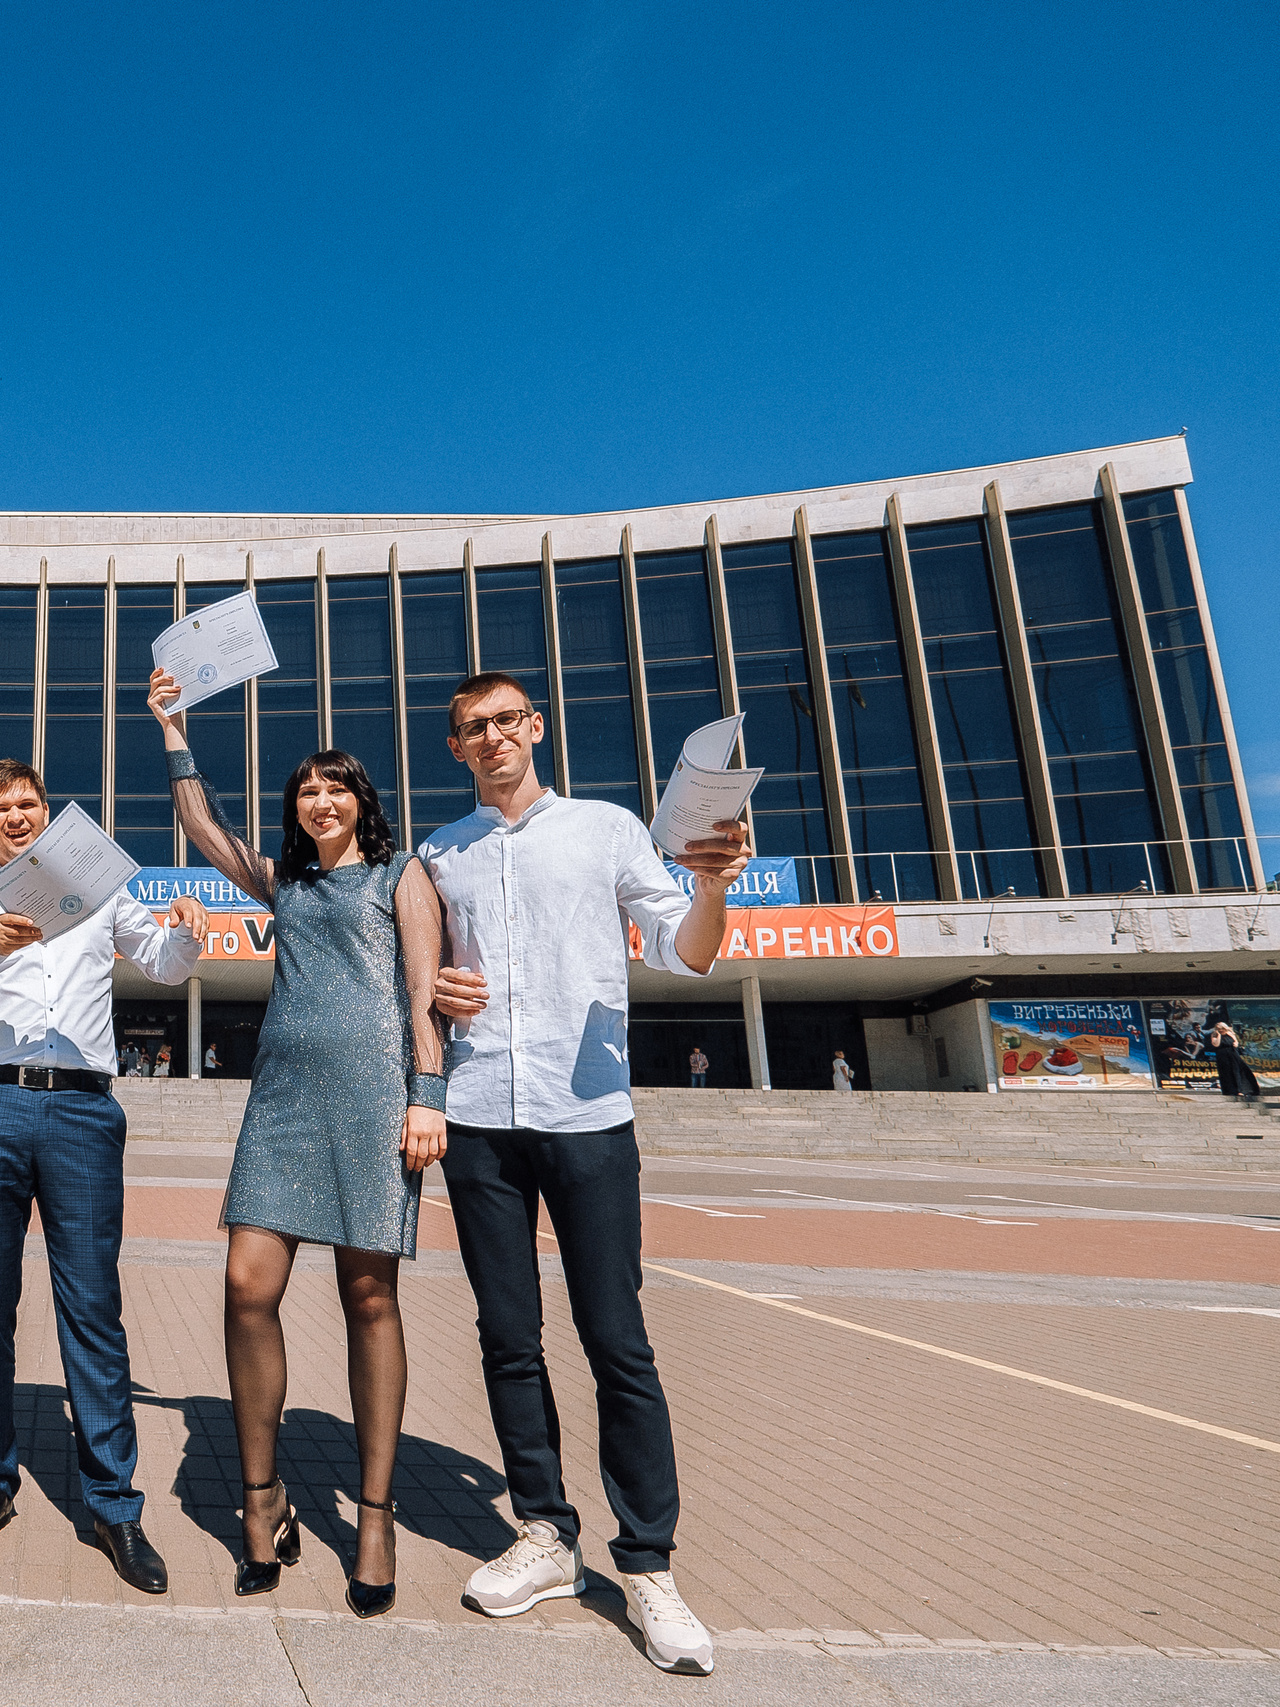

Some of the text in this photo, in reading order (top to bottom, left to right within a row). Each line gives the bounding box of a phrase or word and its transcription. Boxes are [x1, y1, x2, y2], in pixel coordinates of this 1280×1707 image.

[136, 880, 251, 906] МЕДИЧНО
[718, 924, 895, 958] АРЕНКО
[1012, 1003, 1133, 1020] ВИТРЕБЕНЬКИ
